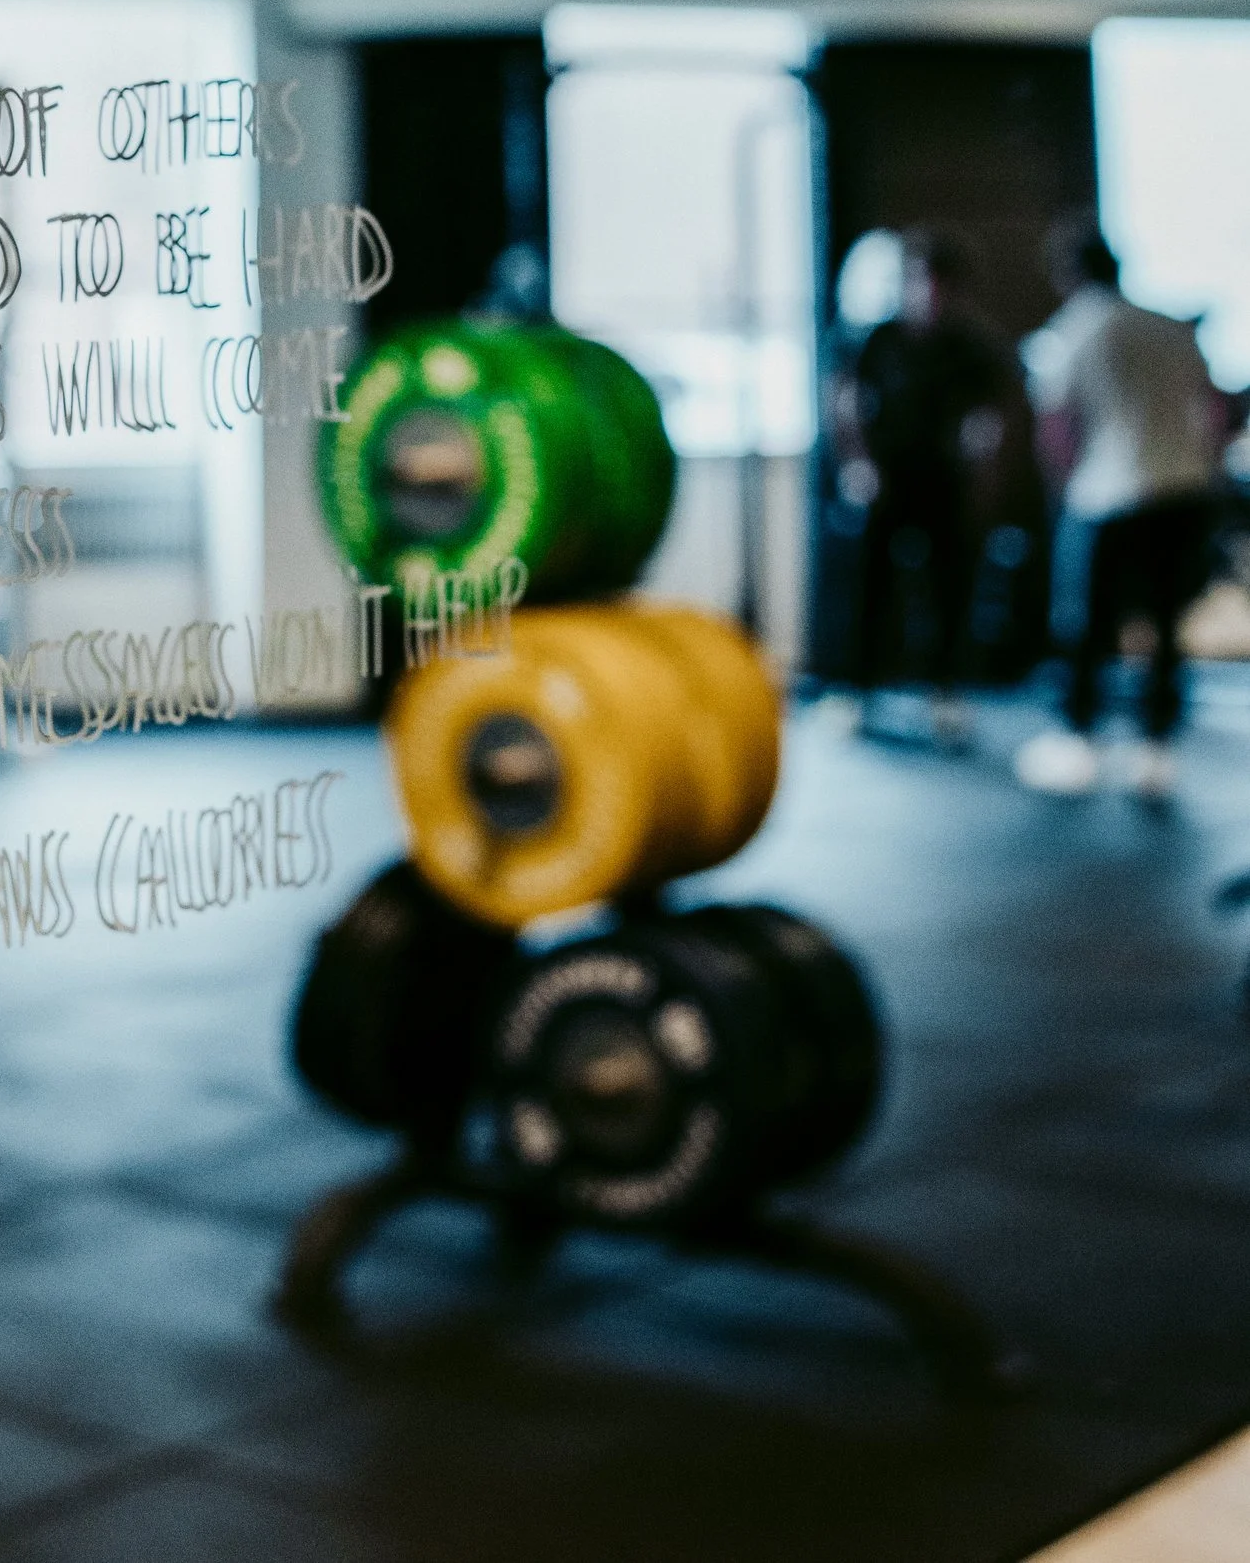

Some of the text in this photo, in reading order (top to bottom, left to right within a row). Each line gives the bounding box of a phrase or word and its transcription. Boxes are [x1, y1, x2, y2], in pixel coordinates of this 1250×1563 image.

[98, 78, 306, 175] OTHERS
[46, 213, 124, 298] TO
[155, 206, 221, 309] BE
[243, 203, 394, 306] HARD
[42, 337, 176, 437] WILL
[201, 323, 352, 431] COME
[402, 555, 529, 670] HELP
[95, 770, 347, 934] CALORIES
